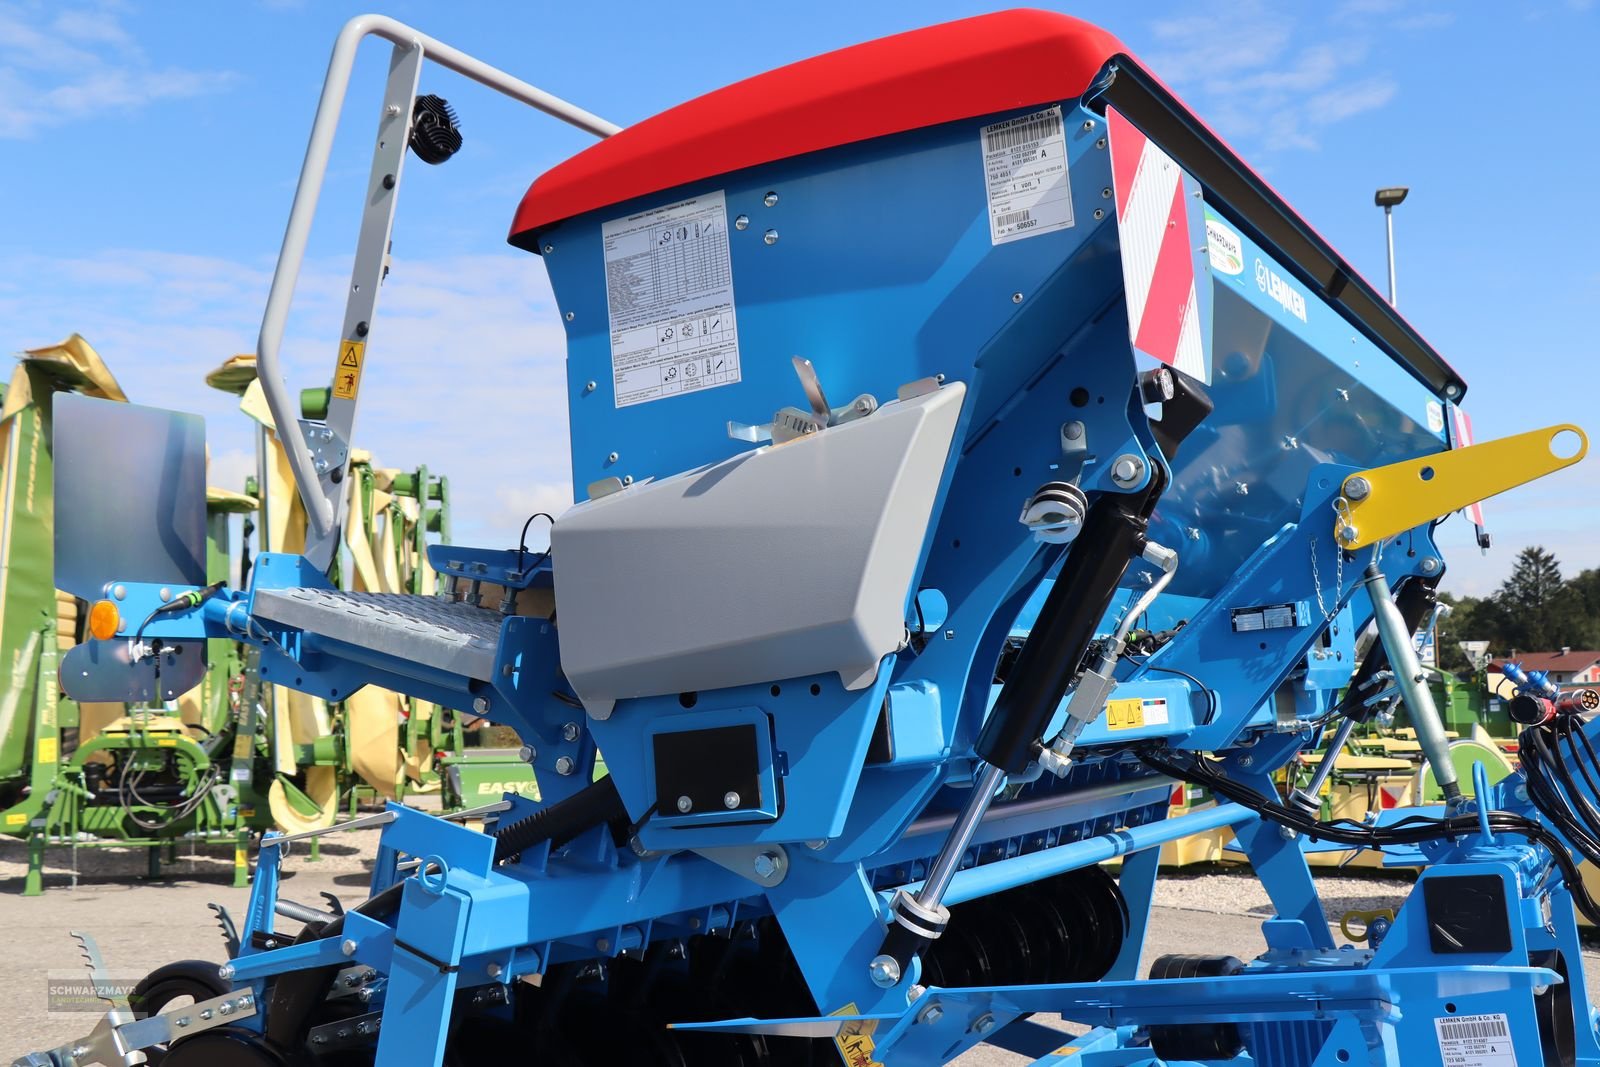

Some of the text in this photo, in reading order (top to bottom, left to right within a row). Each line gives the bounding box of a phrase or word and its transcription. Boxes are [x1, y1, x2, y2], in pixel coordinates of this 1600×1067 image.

[986, 121, 1010, 133] LEMKEN
[1011, 116, 1029, 126] GmbH
[1047, 108, 1056, 116] KG
[1041, 149, 1047, 158] A
[1264, 265, 1308, 324] LEMKEN
[1491, 1045, 1497, 1053] A
